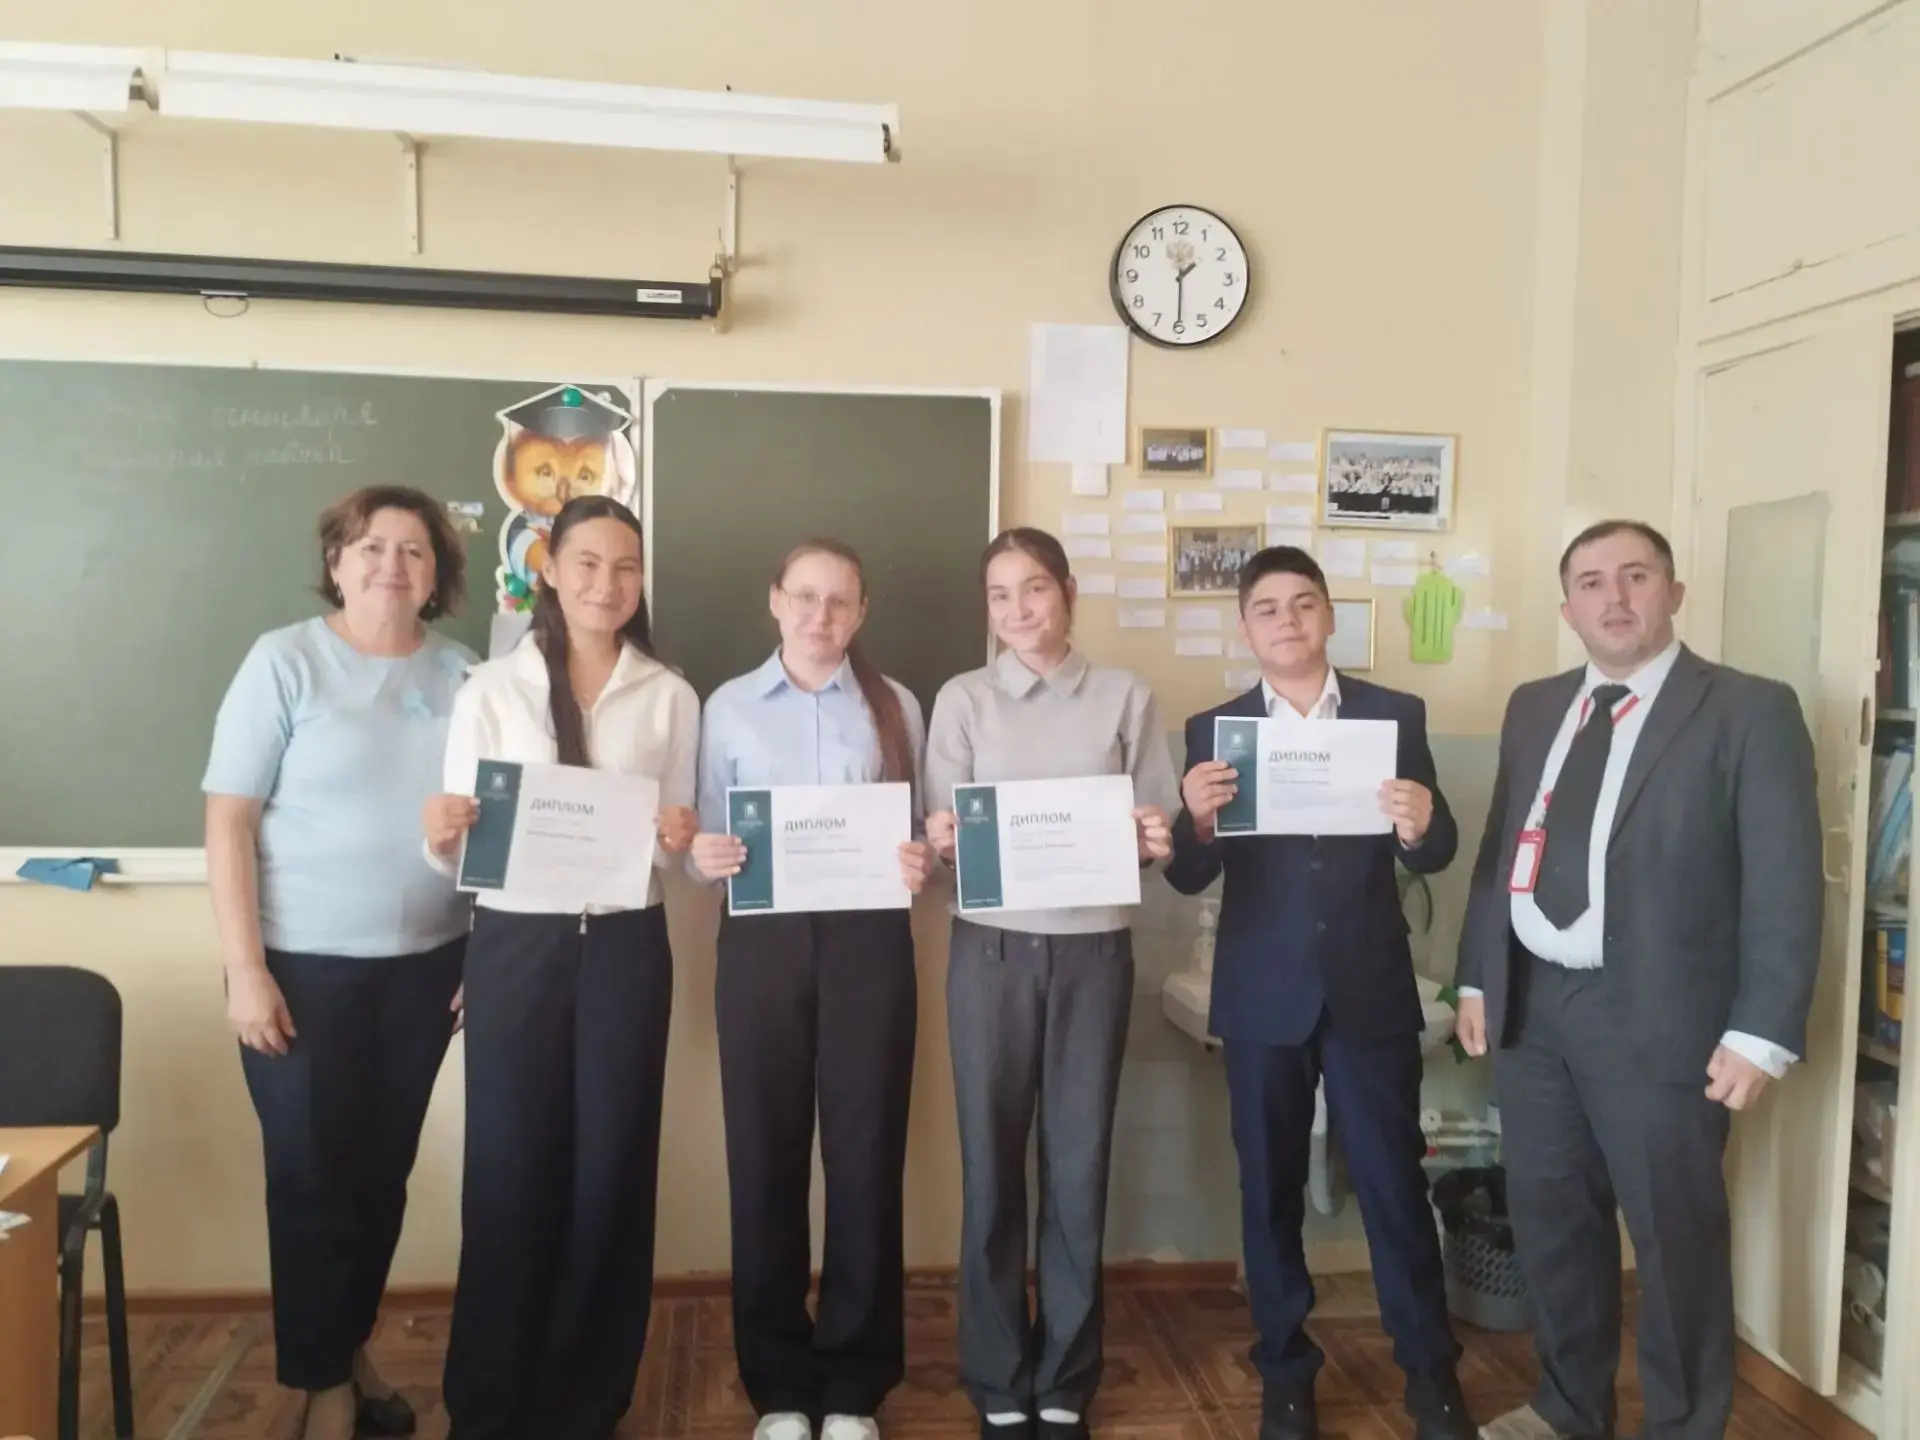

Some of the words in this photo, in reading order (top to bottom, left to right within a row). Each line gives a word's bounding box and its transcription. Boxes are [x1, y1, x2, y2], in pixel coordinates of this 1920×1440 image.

[1151, 227, 1164, 240] 11
[1172, 221, 1189, 235] 12
[1201, 229, 1208, 241] 1
[1133, 245, 1150, 259] 10
[1216, 247, 1227, 261] 2
[1126, 269, 1139, 283] 9
[1222, 272, 1234, 287] 3
[1133, 295, 1145, 308] 8
[1213, 297, 1225, 310] 4
[1152, 313, 1162, 327] 7
[1172, 320, 1186, 334] 6
[1196, 314, 1208, 328] 5
[1268, 751, 1332, 763] ДИПЛОМ
[529, 798, 596, 816] ДИПЛОМ
[784, 817, 847, 833] ДИПЛОМ
[1010, 812, 1073, 828] ДИПЛОМ
